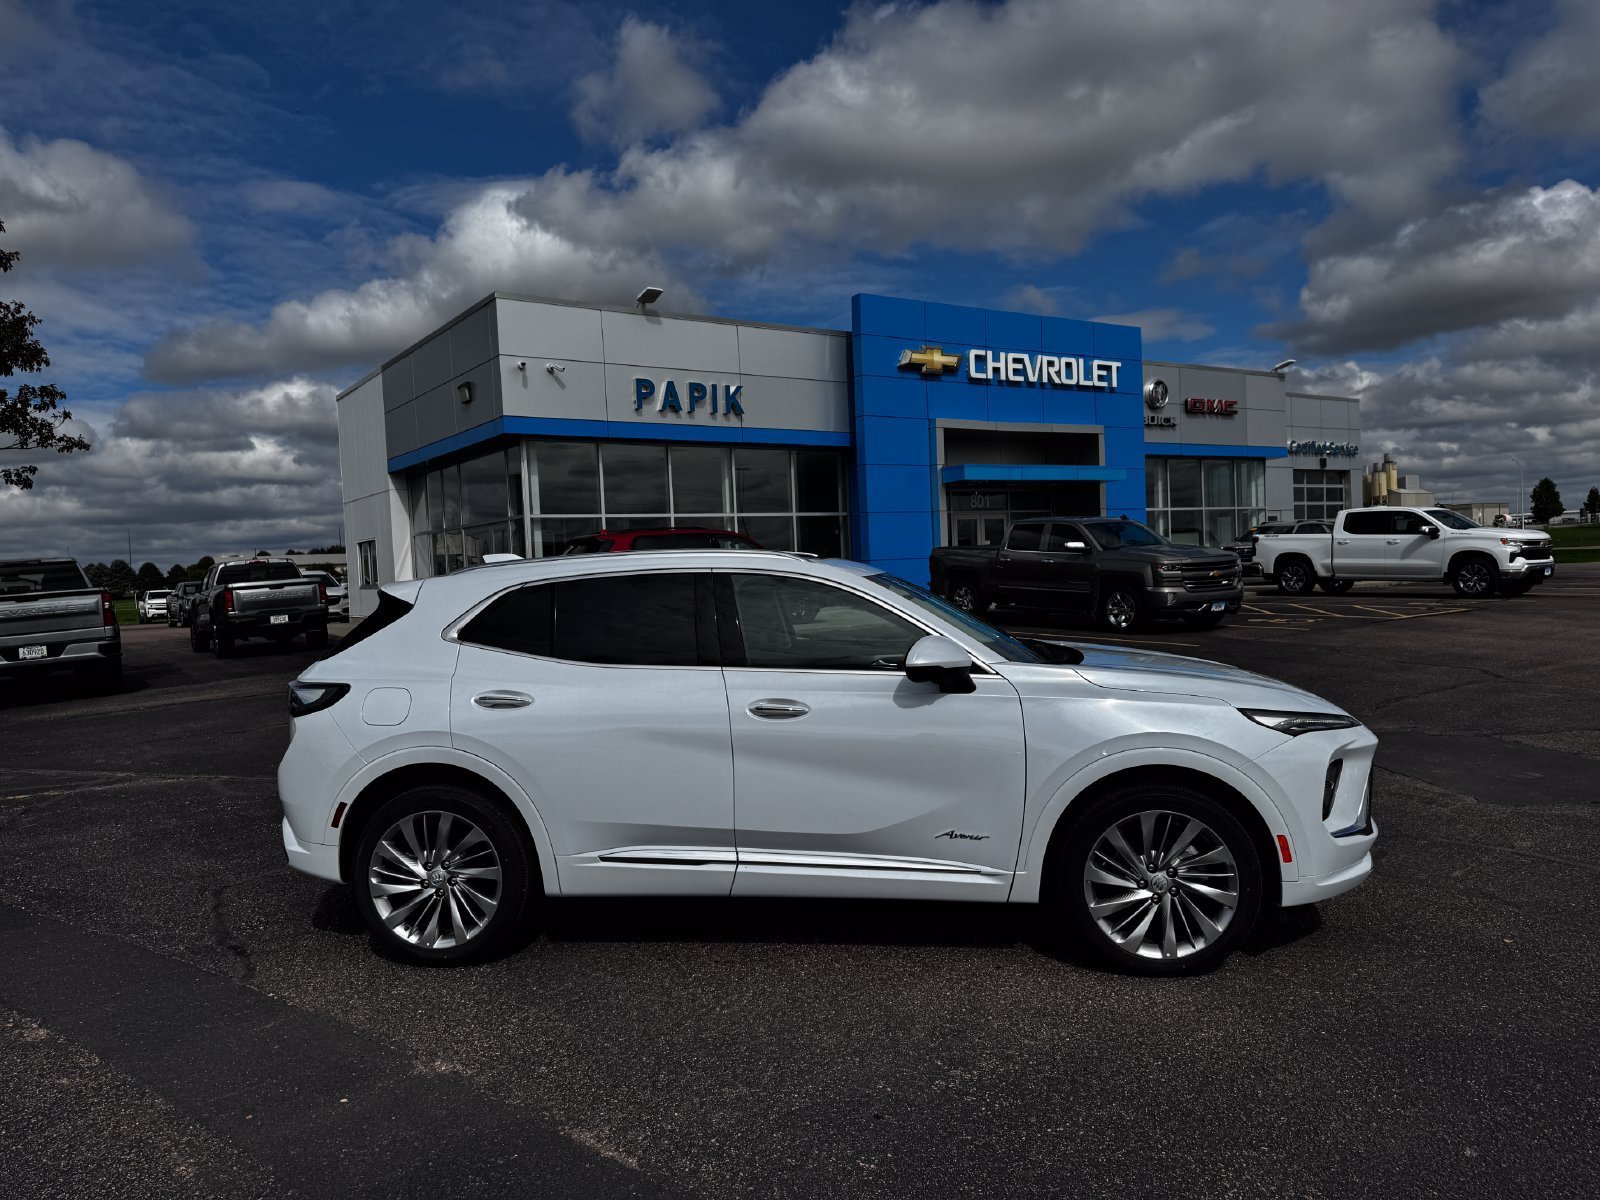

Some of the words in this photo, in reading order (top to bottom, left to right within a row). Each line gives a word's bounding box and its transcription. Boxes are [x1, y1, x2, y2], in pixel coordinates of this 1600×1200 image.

[968, 349, 1122, 388] CHEVROLET
[632, 377, 745, 415] PAPIK
[1186, 398, 1238, 416] GMC
[1288, 440, 1327, 455] Certified
[1327, 441, 1359, 457] Service
[970, 494, 990, 508] 801
